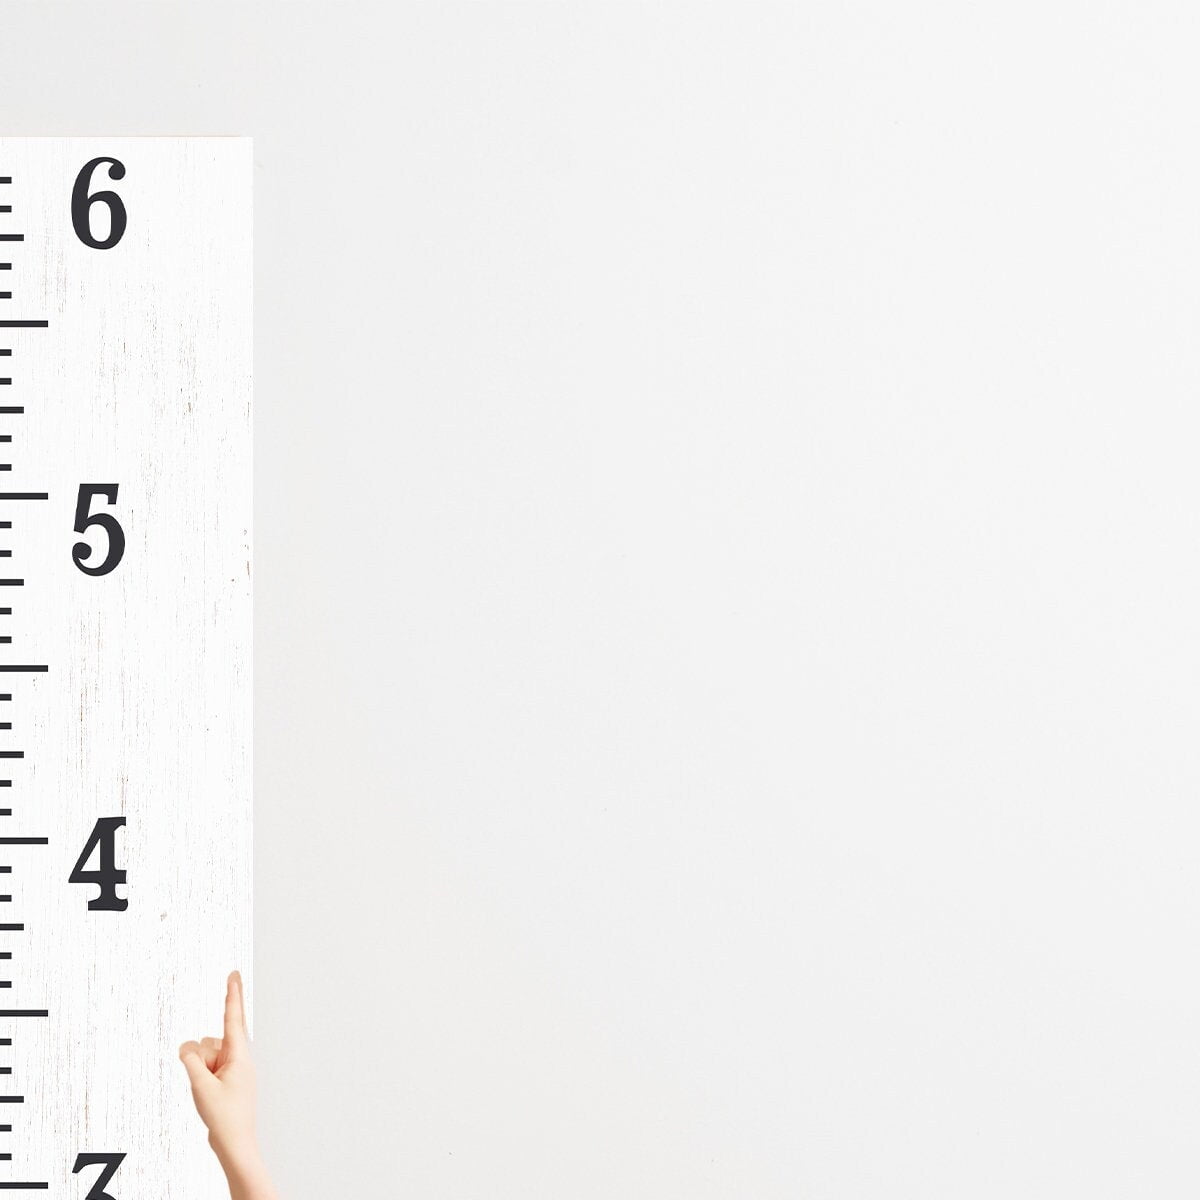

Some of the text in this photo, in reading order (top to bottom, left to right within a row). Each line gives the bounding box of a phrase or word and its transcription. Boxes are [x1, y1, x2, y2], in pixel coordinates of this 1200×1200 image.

[71, 156, 127, 250] 6
[71, 483, 126, 577] 5
[68, 816, 129, 912] 4
